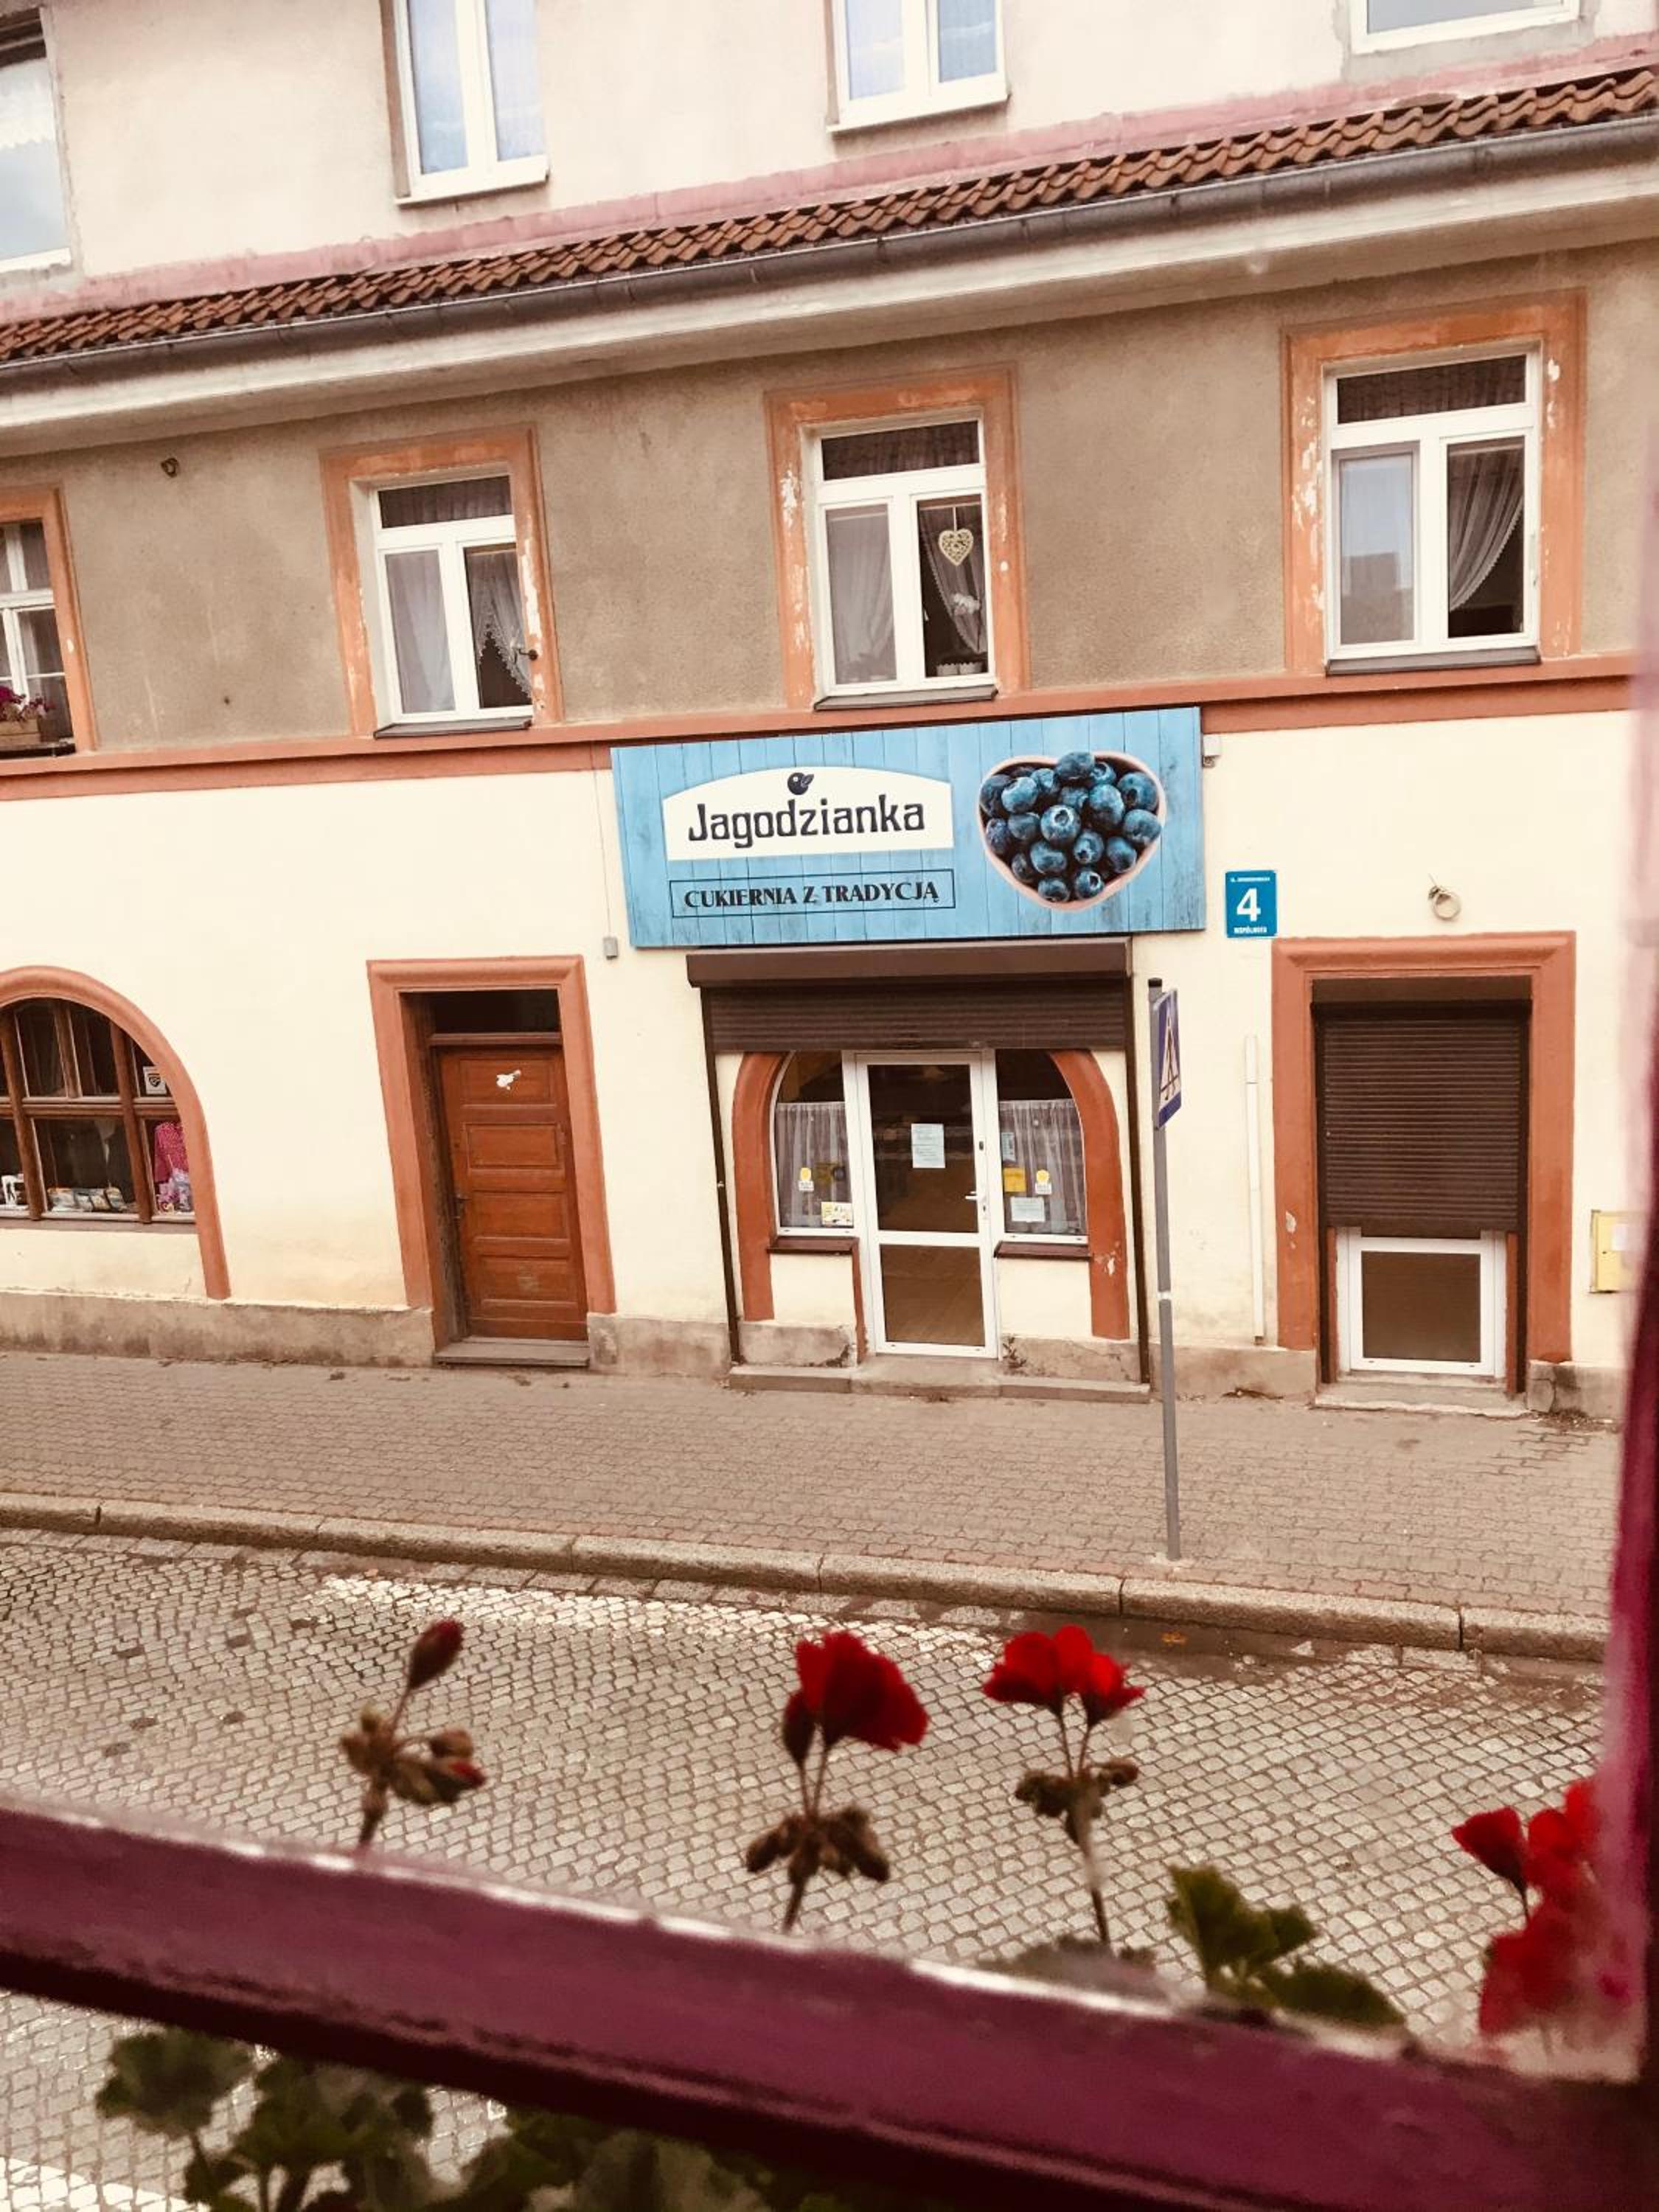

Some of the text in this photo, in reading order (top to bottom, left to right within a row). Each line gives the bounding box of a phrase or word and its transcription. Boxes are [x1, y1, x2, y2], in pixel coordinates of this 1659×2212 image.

[688, 794, 925, 849] Jagodzianka
[684, 880, 940, 908] CUKIERNIA Z TRADYCJĄ
[1237, 887, 1262, 922] 4
